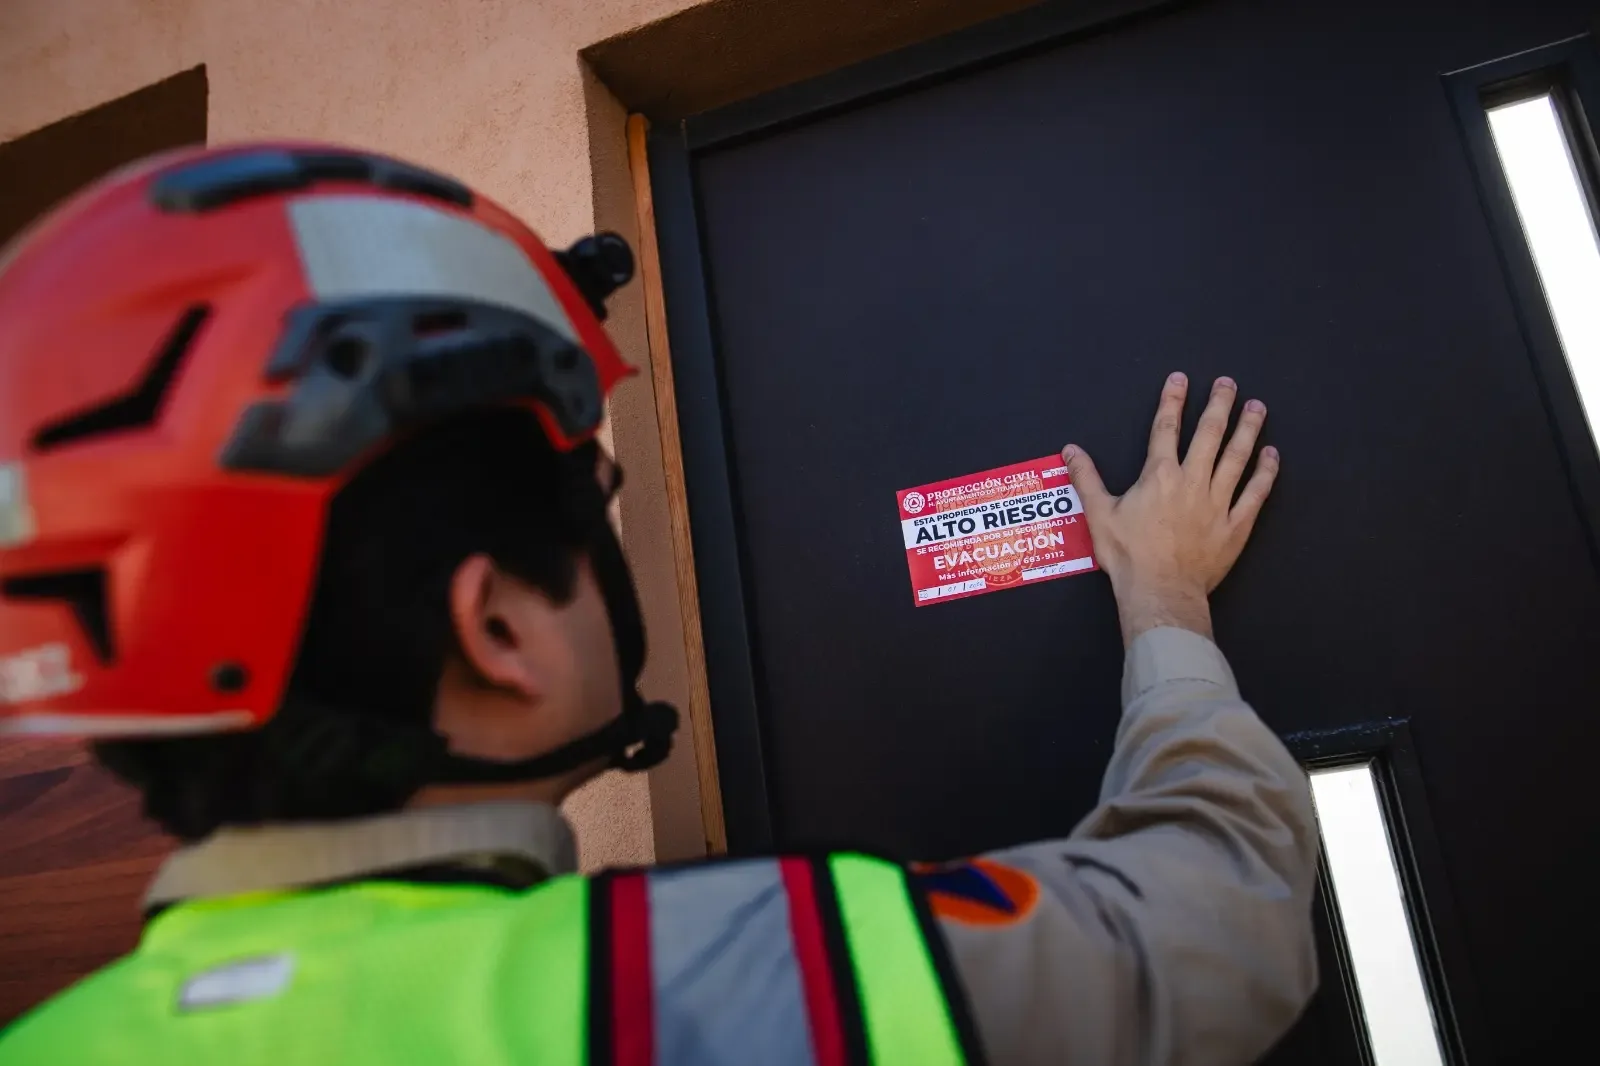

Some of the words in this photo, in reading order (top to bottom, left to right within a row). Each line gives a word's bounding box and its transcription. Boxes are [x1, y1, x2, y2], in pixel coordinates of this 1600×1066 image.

[926, 477, 1002, 502] PROTECCIÓN
[1004, 470, 1038, 484] CIVIL
[914, 516, 935, 526] ESTA
[936, 504, 988, 522] PROPIEDAD
[990, 502, 1000, 510] SE
[1002, 492, 1055, 508] CONSIDERA
[1056, 487, 1070, 496] DE
[916, 518, 976, 544] ALTO
[982, 496, 1072, 530] RIESGO
[916, 548, 927, 556] SE
[928, 537, 982, 553] RECOMIENDA
[983, 532, 1001, 542] POR
[1002, 529, 1014, 537] SU
[1015, 519, 1064, 535] SEGURIDAD
[1065, 516, 1077, 525] LA
[933, 531, 1064, 570] EVACUACIÓN
[938, 572, 956, 581] Más
[958, 560, 1012, 578] información
[1013, 558, 1022, 566] al
[1023, 550, 1065, 564] 683-9112
